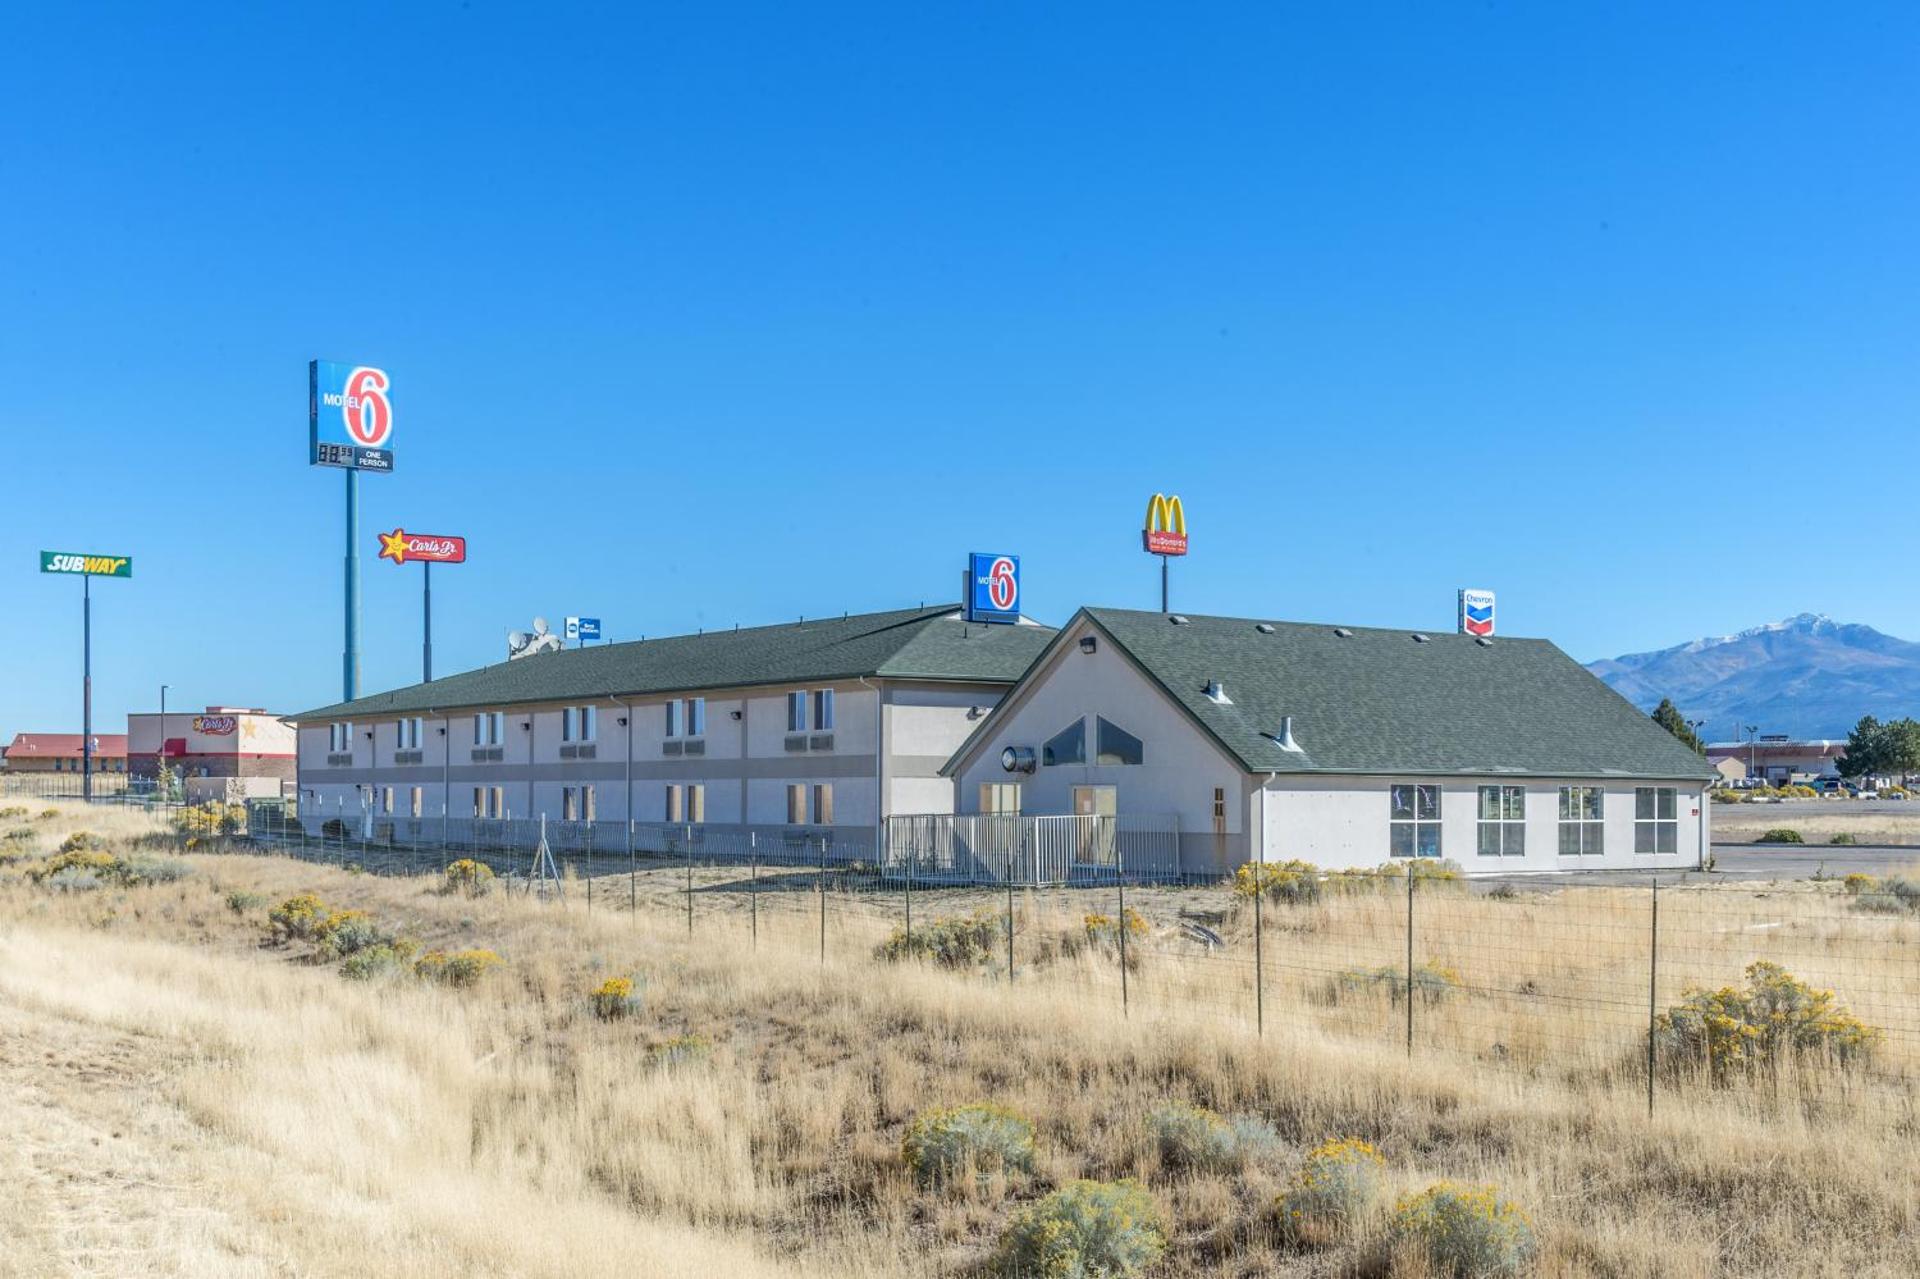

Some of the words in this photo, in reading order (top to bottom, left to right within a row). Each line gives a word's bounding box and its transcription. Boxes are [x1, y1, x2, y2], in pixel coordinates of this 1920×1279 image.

[323, 393, 361, 409] MOTEL
[343, 366, 393, 447] 6
[359, 457, 388, 468] PERSON
[365, 450, 381, 459] ONE
[47, 555, 127, 574] SUBWAY
[978, 576, 1000, 587] MOTEL
[989, 557, 1017, 610] 6
